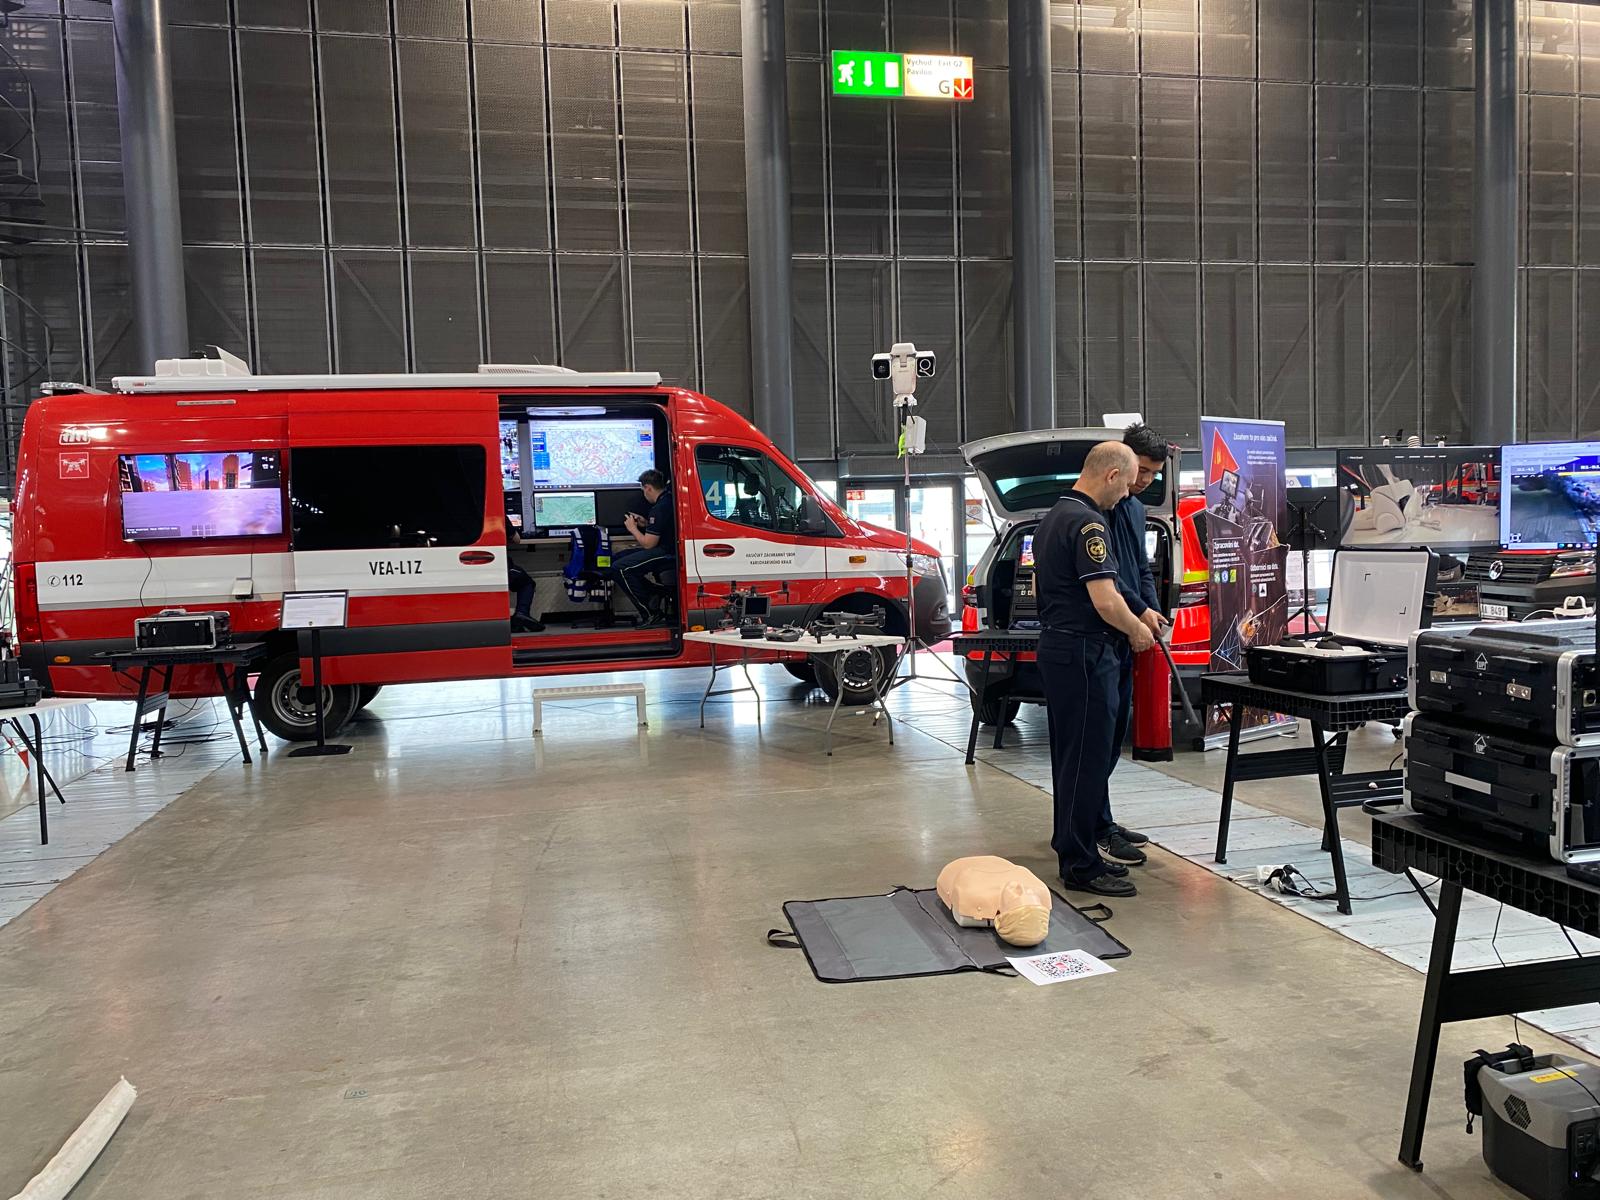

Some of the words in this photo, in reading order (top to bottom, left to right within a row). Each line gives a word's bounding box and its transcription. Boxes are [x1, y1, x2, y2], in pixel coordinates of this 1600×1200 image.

[938, 80, 950, 94] G
[705, 481, 722, 506] 4
[369, 560, 422, 575] VEA-L1Z
[62, 574, 83, 586] 112
